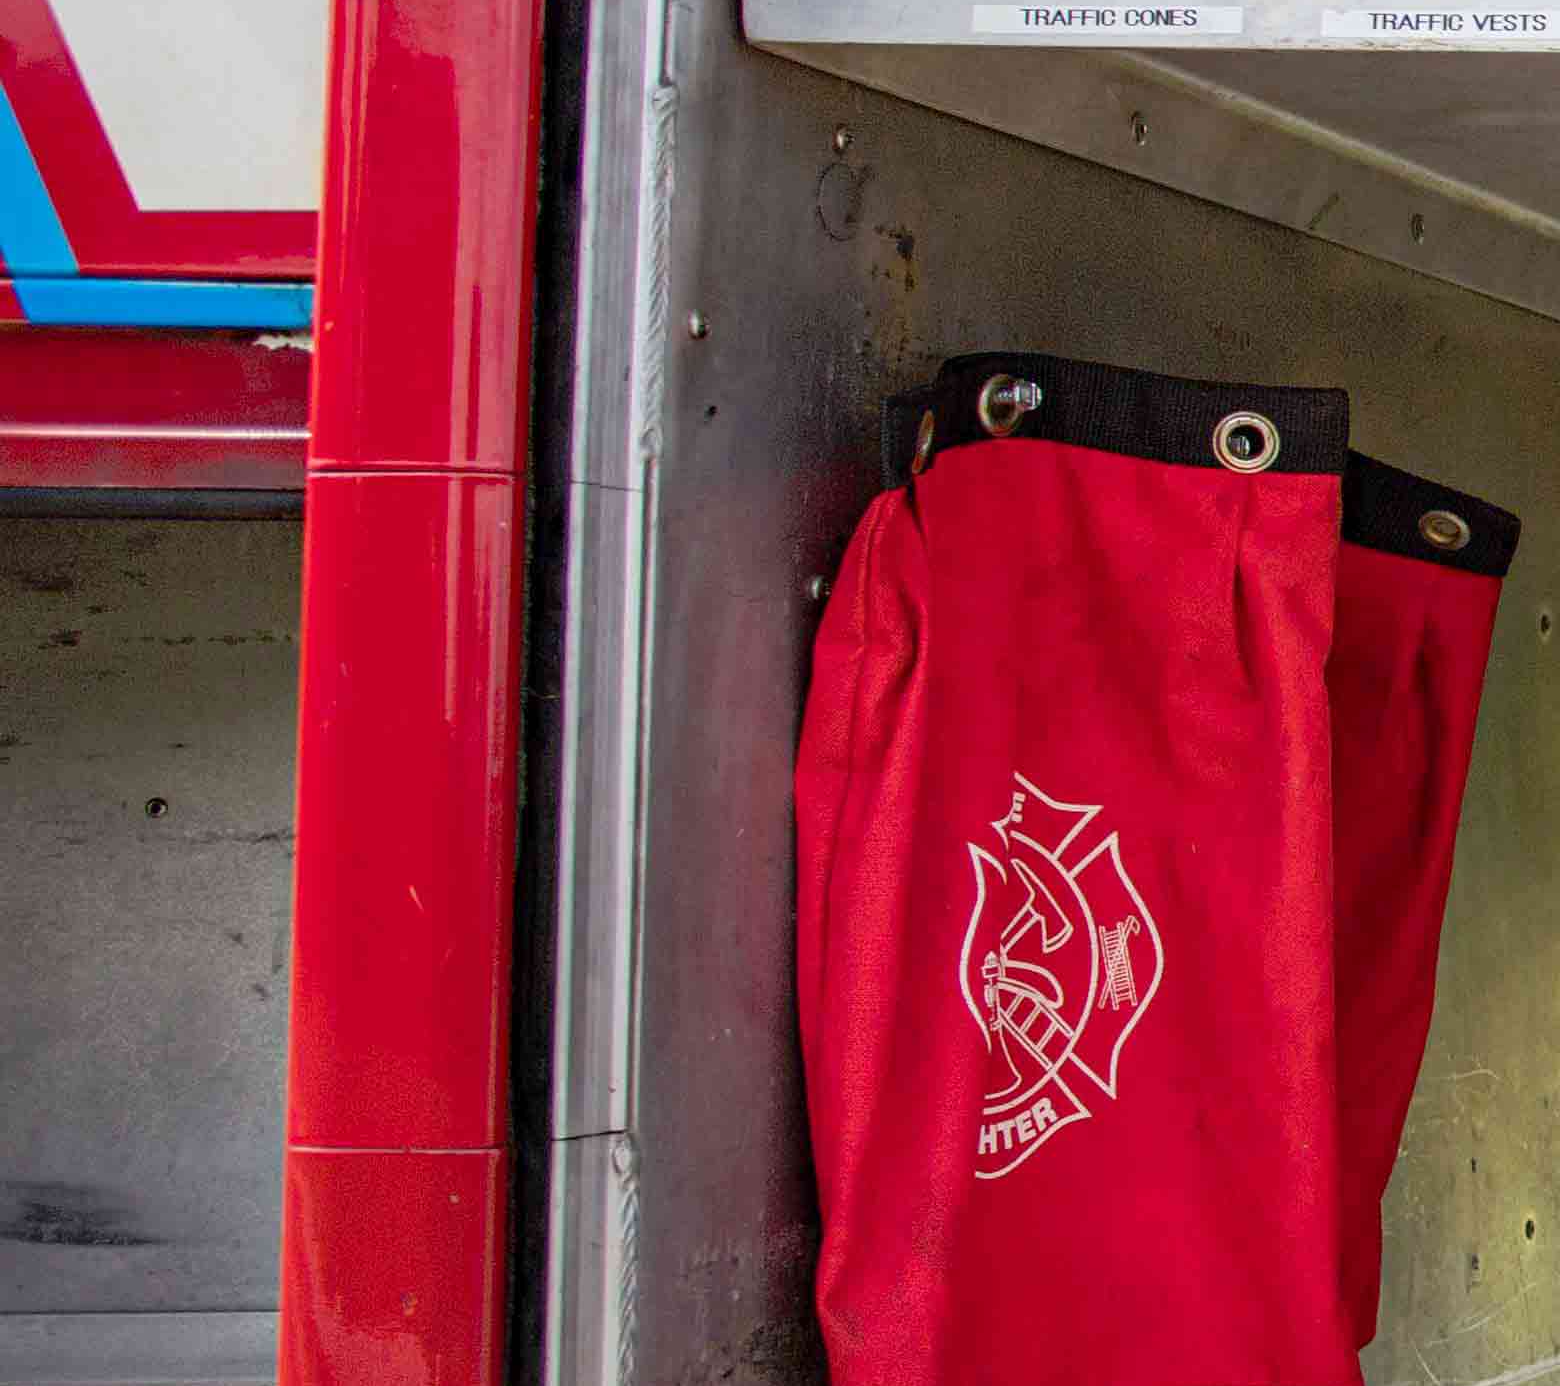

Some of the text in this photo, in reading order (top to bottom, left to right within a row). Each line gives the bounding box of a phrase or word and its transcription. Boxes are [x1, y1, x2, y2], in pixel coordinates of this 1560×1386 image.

[1020, 8, 1198, 27] TRAFFIC CONES
[1368, 13, 1548, 32] TRAFFIC VESTS
